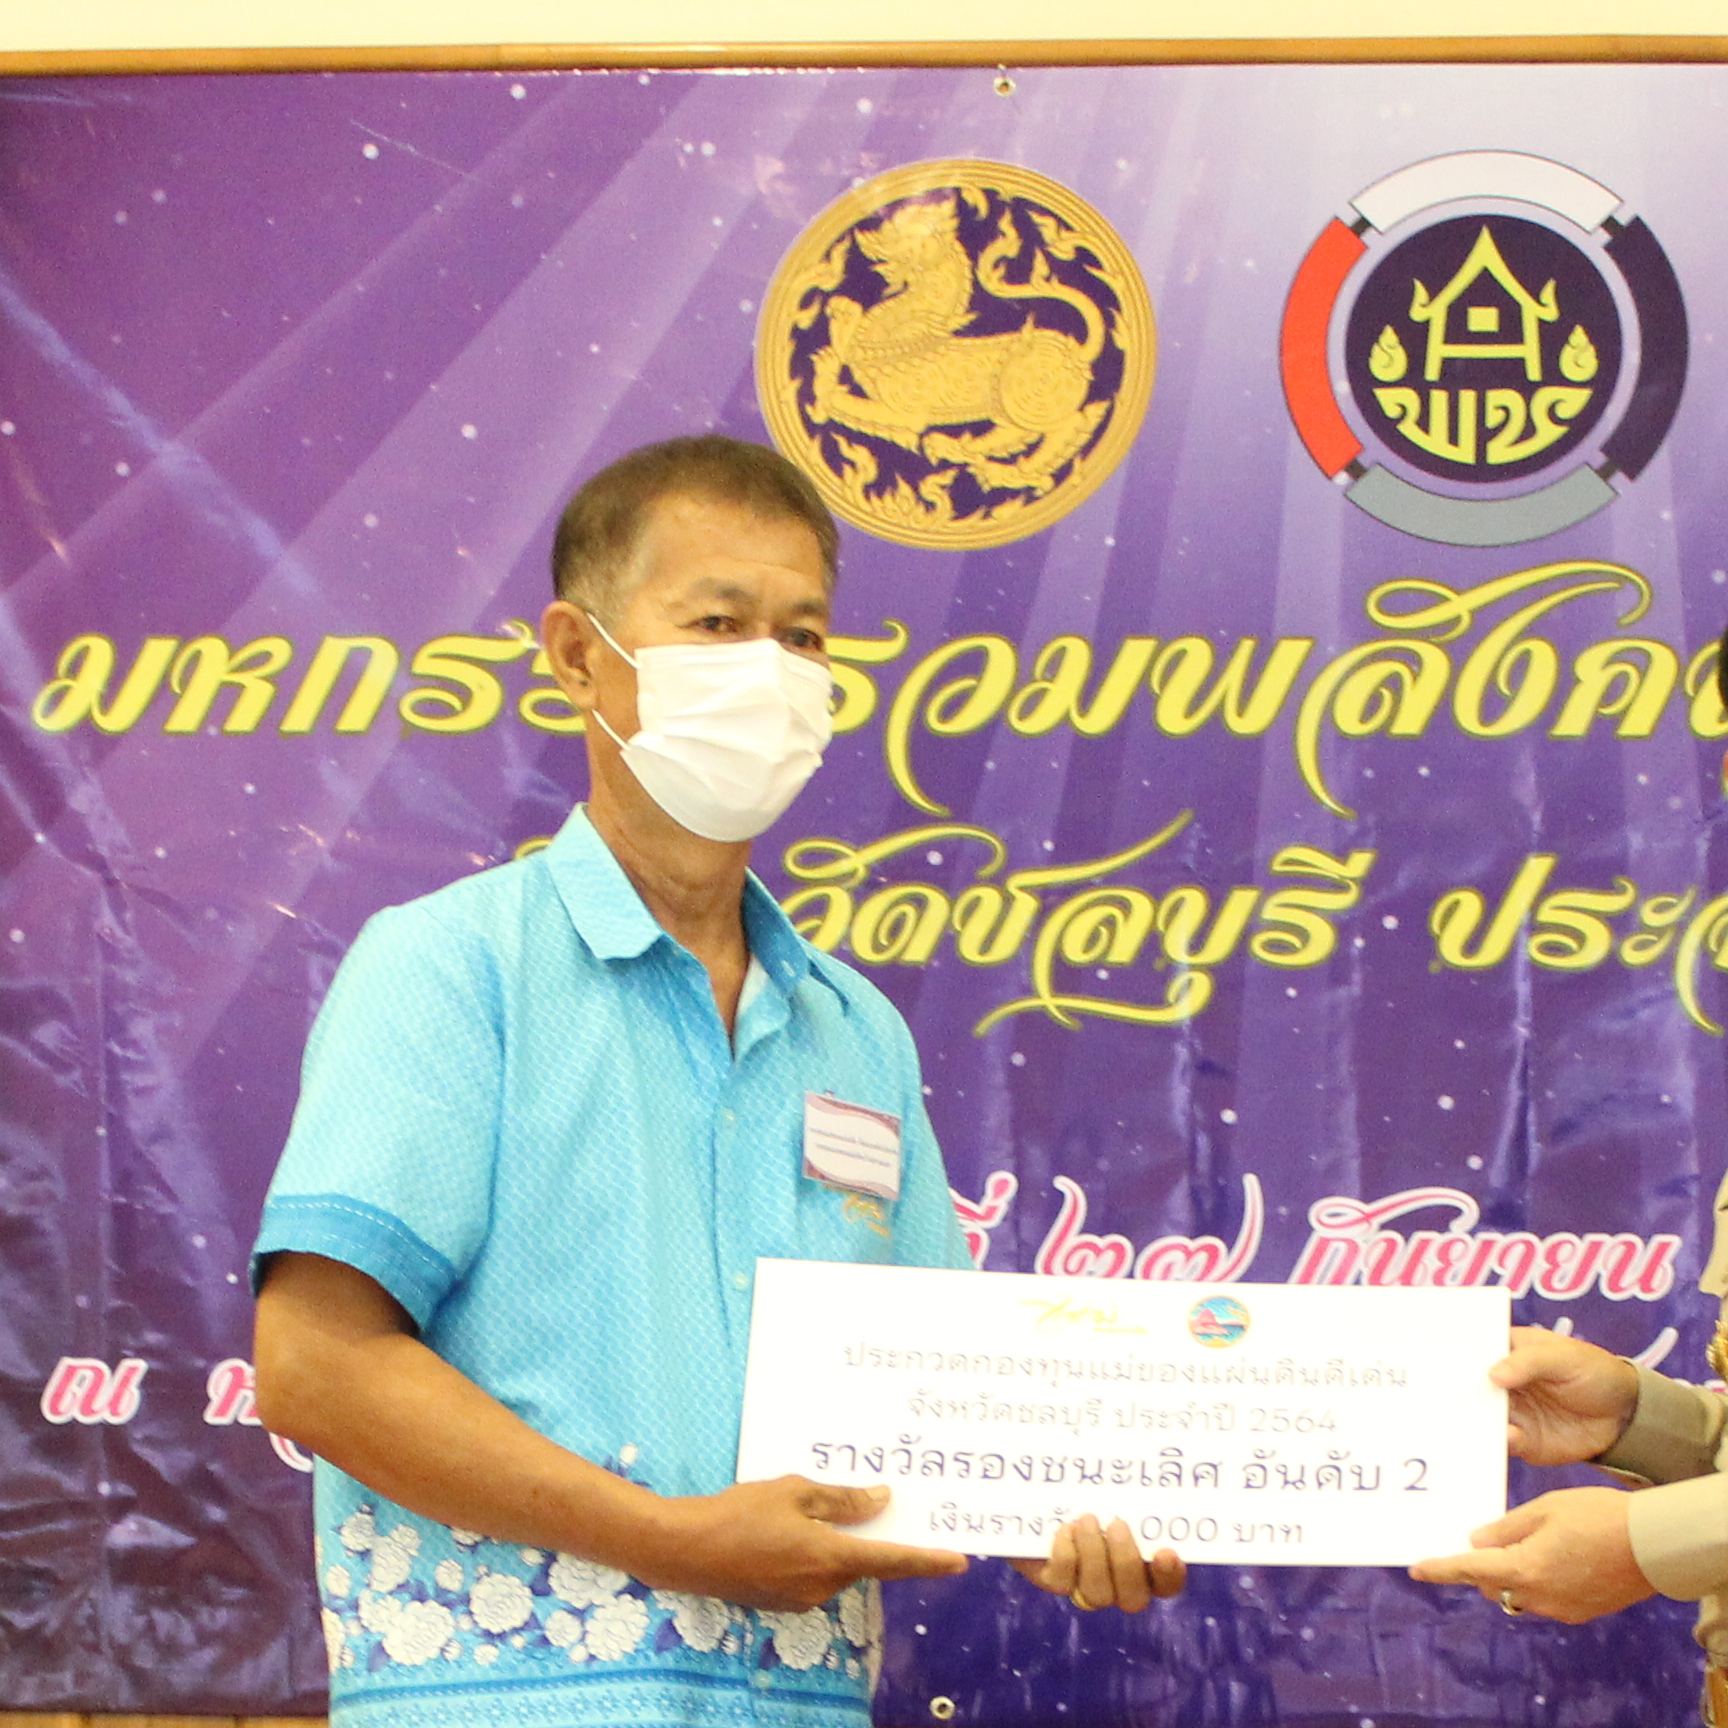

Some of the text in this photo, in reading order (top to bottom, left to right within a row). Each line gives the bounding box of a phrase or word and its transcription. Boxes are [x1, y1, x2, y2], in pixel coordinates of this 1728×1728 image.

[1286, 1185, 1683, 1302] กันยายน
[40, 1356, 150, 1426] ณ
[843, 1340, 1409, 1389] ประกวดกองทุนแม่ของแผ่นดินดีเด่น
[906, 1387, 1339, 1437] จังหวัดชลบุรี ประจำปี 2564
[809, 1432, 1431, 1494] รางวัลรองชนะเลิศ อันดับ 2
[1231, 1520, 1305, 1545] บาท
